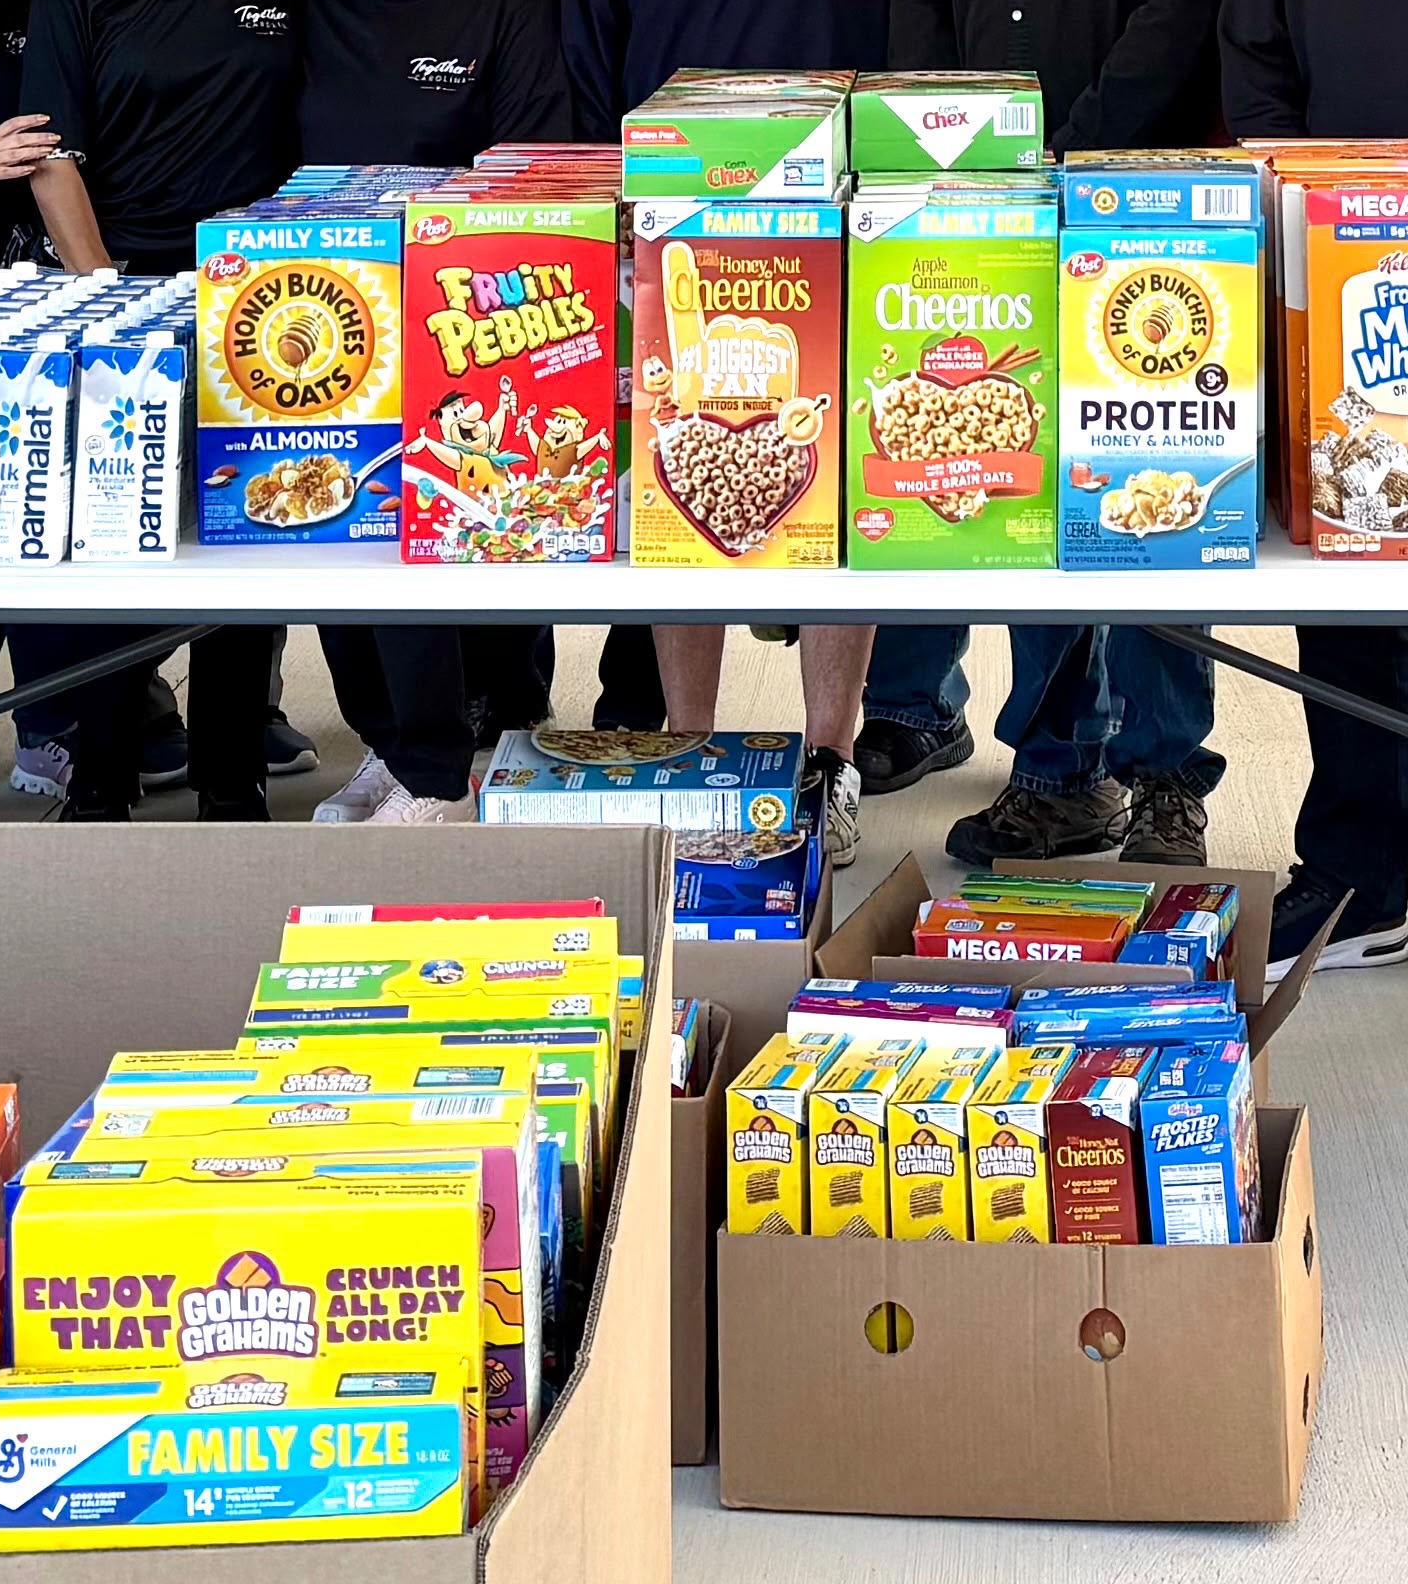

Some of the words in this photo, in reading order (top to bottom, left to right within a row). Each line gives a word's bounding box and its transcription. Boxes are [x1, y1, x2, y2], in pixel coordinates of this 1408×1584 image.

[410, 57, 466, 76] Together
[414, 74, 466, 84] CAROLINA
[923, 110, 970, 130] Chex
[706, 166, 759, 188] Chex
[1126, 189, 1181, 202] PROTEIN
[416, 217, 449, 241] Post
[464, 210, 528, 227] FAMILY
[532, 210, 573, 227] SIZE
[703, 212, 773, 233] FAMILY
[778, 211, 820, 233] SIZE
[226, 227, 312, 249] FAMILY
[319, 227, 373, 249] SIZE
[1110, 239, 1167, 255] FAMILY
[1172, 239, 1207, 254] SIZE
[208, 256, 242, 279] Post
[719, 255, 769, 278] Honey
[773, 256, 801, 274] Nut
[913, 257, 947, 275] Apple
[1071, 252, 1104, 274] Post
[668, 268, 813, 312] Cheerios
[911, 274, 979, 290] Cinnamon
[288, 273, 365, 356] BUNCHES
[875, 282, 1033, 331] Cheerios
[1110, 277, 1146, 336] HONEY
[1150, 274, 1208, 336] BUNCHES
[234, 277, 282, 358] HONEY
[678, 342, 704, 374] #1
[707, 337, 791, 375] BIGGEST
[1123, 344, 1141, 360] of
[1141, 343, 1197, 374] OATS
[250, 368, 276, 390] of
[275, 364, 352, 408] OATS
[702, 372, 769, 398] FAN
[698, 400, 738, 411] TATTOOS
[1080, 400, 1236, 431] PROTEIN
[225, 441, 248, 451] with
[249, 430, 359, 451] ALMONDS
[1091, 435, 1141, 446] HONEY
[1146, 435, 1157, 446] &
[1163, 435, 1225, 446] ALMOND
[89, 458, 135, 476] Milk
[138, 400, 167, 552] parmalat
[947, 459, 983, 476] 100%
[20, 405, 53, 559] parmalat
[895, 478, 939, 493] WHOLE
[942, 474, 980, 490] GRAIN
[983, 471, 1014, 485] OATS
[1065, 521, 1101, 538] CEREAL
[947, 940, 1018, 960] MEGA
[1026, 943, 1082, 961] SIZE
[270, 963, 393, 981] FAMILY
[285, 975, 359, 990] SIZE
[1151, 1115, 1220, 1139] FROSTED
[1154, 1129, 1215, 1152] FLAKES
[1056, 1147, 1125, 1167] Cheerios
[1082, 1231, 1092, 1240] 12
[326, 1265, 460, 1292] CRUNCH
[23, 1274, 176, 1310] ENJOY
[326, 1294, 390, 1318] ALL
[397, 1291, 465, 1314] DAY
[51, 1316, 172, 1350] THAT
[326, 1317, 428, 1343] LONG!
[30, 1444, 77, 1457] General
[128, 1425, 298, 1476] FAMILY
[310, 1420, 409, 1468] SIZE
[30, 1457, 57, 1468] Mills
[344, 1481, 372, 1509] 12
